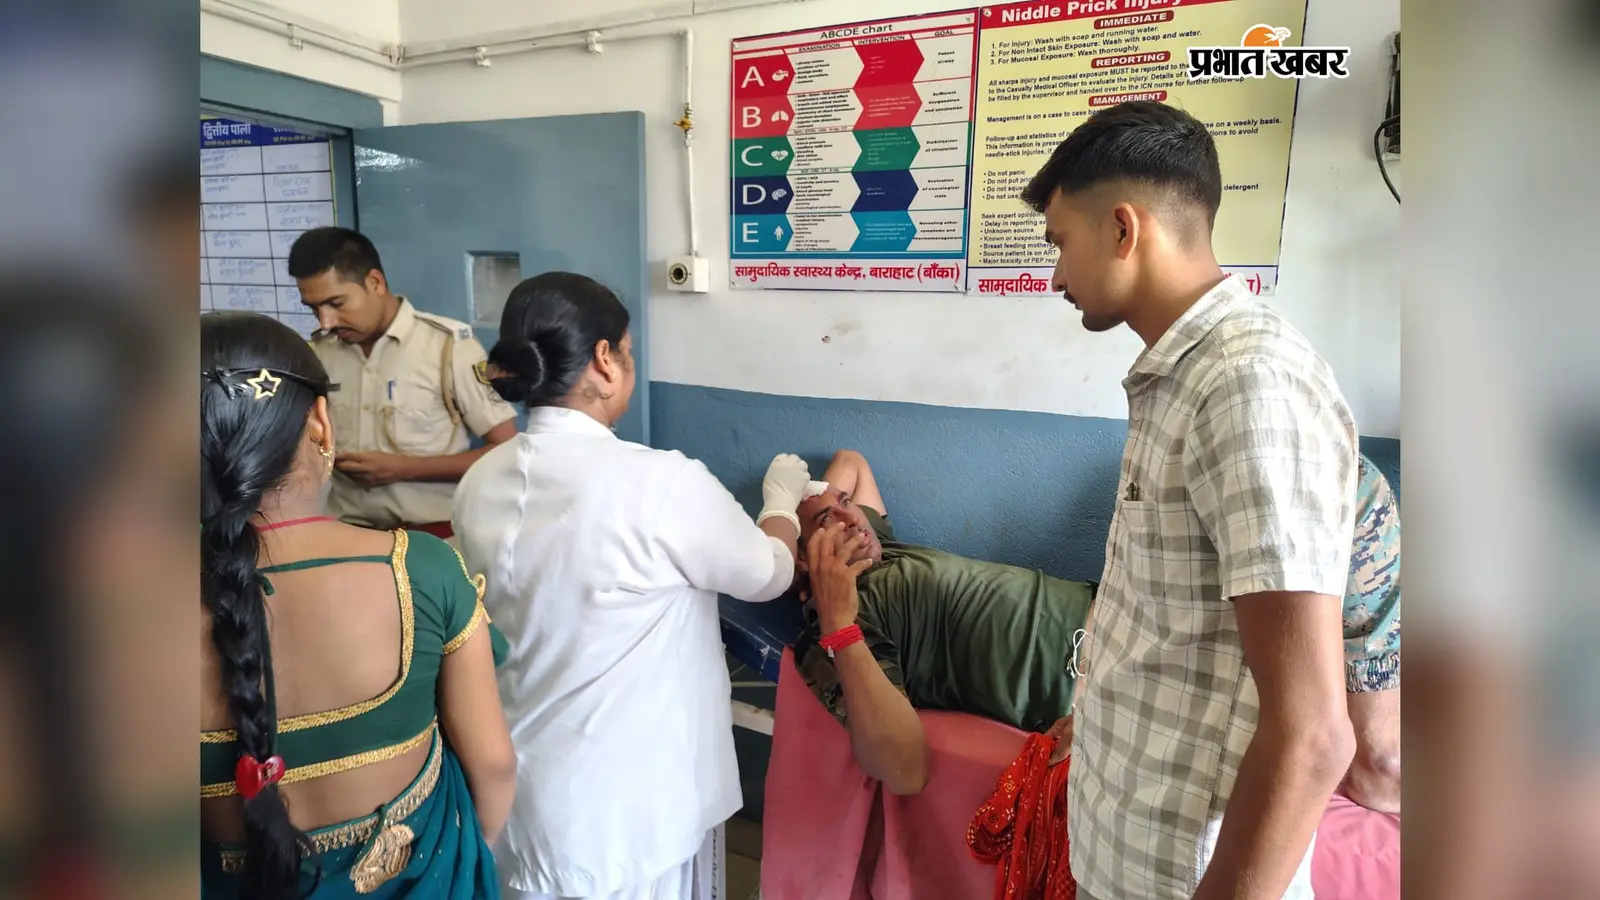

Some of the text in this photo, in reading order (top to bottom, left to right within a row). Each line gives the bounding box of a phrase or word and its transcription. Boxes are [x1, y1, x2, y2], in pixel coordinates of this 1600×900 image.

[1002, 8, 1062, 23] Niddle
[1067, 0, 1117, 15] Prick
[1100, 13, 1167, 27] IMMEDIATE
[820, 24, 893, 39] ABCDE chart
[858, 36, 905, 44] INTERVENTION
[1012, 40, 1033, 48] Injury:
[1072, 34, 1089, 42] soap
[1106, 29, 1134, 38] running
[1137, 26, 1159, 34] water.
[1065, 41, 1100, 50] Exposure:
[1103, 38, 1122, 46] Wash
[1142, 33, 1160, 42] soap
[1179, 29, 1202, 38] water.
[799, 44, 840, 52] EXAMINATION
[1011, 55, 1038, 63] Mucosal
[1041, 52, 1075, 61] Exposure:
[1099, 44, 1140, 54] thoroughly.
[1096, 54, 1165, 66] REPORTING
[741, 66, 765, 88] A
[1079, 71, 1108, 79] exposure
[1110, 68, 1129, 76] MUST
[1141, 64, 1168, 73] reported
[1007, 84, 1032, 93] Casualty
[1060, 80, 1079, 88] Officer
[1129, 75, 1148, 83] injury.
[1151, 72, 1174, 80] Details
[1033, 90, 1064, 98] supervisor
[1186, 78, 1210, 86] further
[1094, 92, 1162, 104] MANAGEMENT
[743, 106, 762, 128] B
[987, 115, 1025, 123] Management
[741, 145, 763, 166] C
[743, 184, 766, 205] D
[1224, 183, 1258, 191] detergent
[743, 223, 759, 242] E
[734, 262, 791, 282] सामुदायिक
[793, 266, 832, 277] स्वास्थ्य
[870, 267, 915, 280] बाराहाट
[917, 263, 960, 283] (बाँका)
